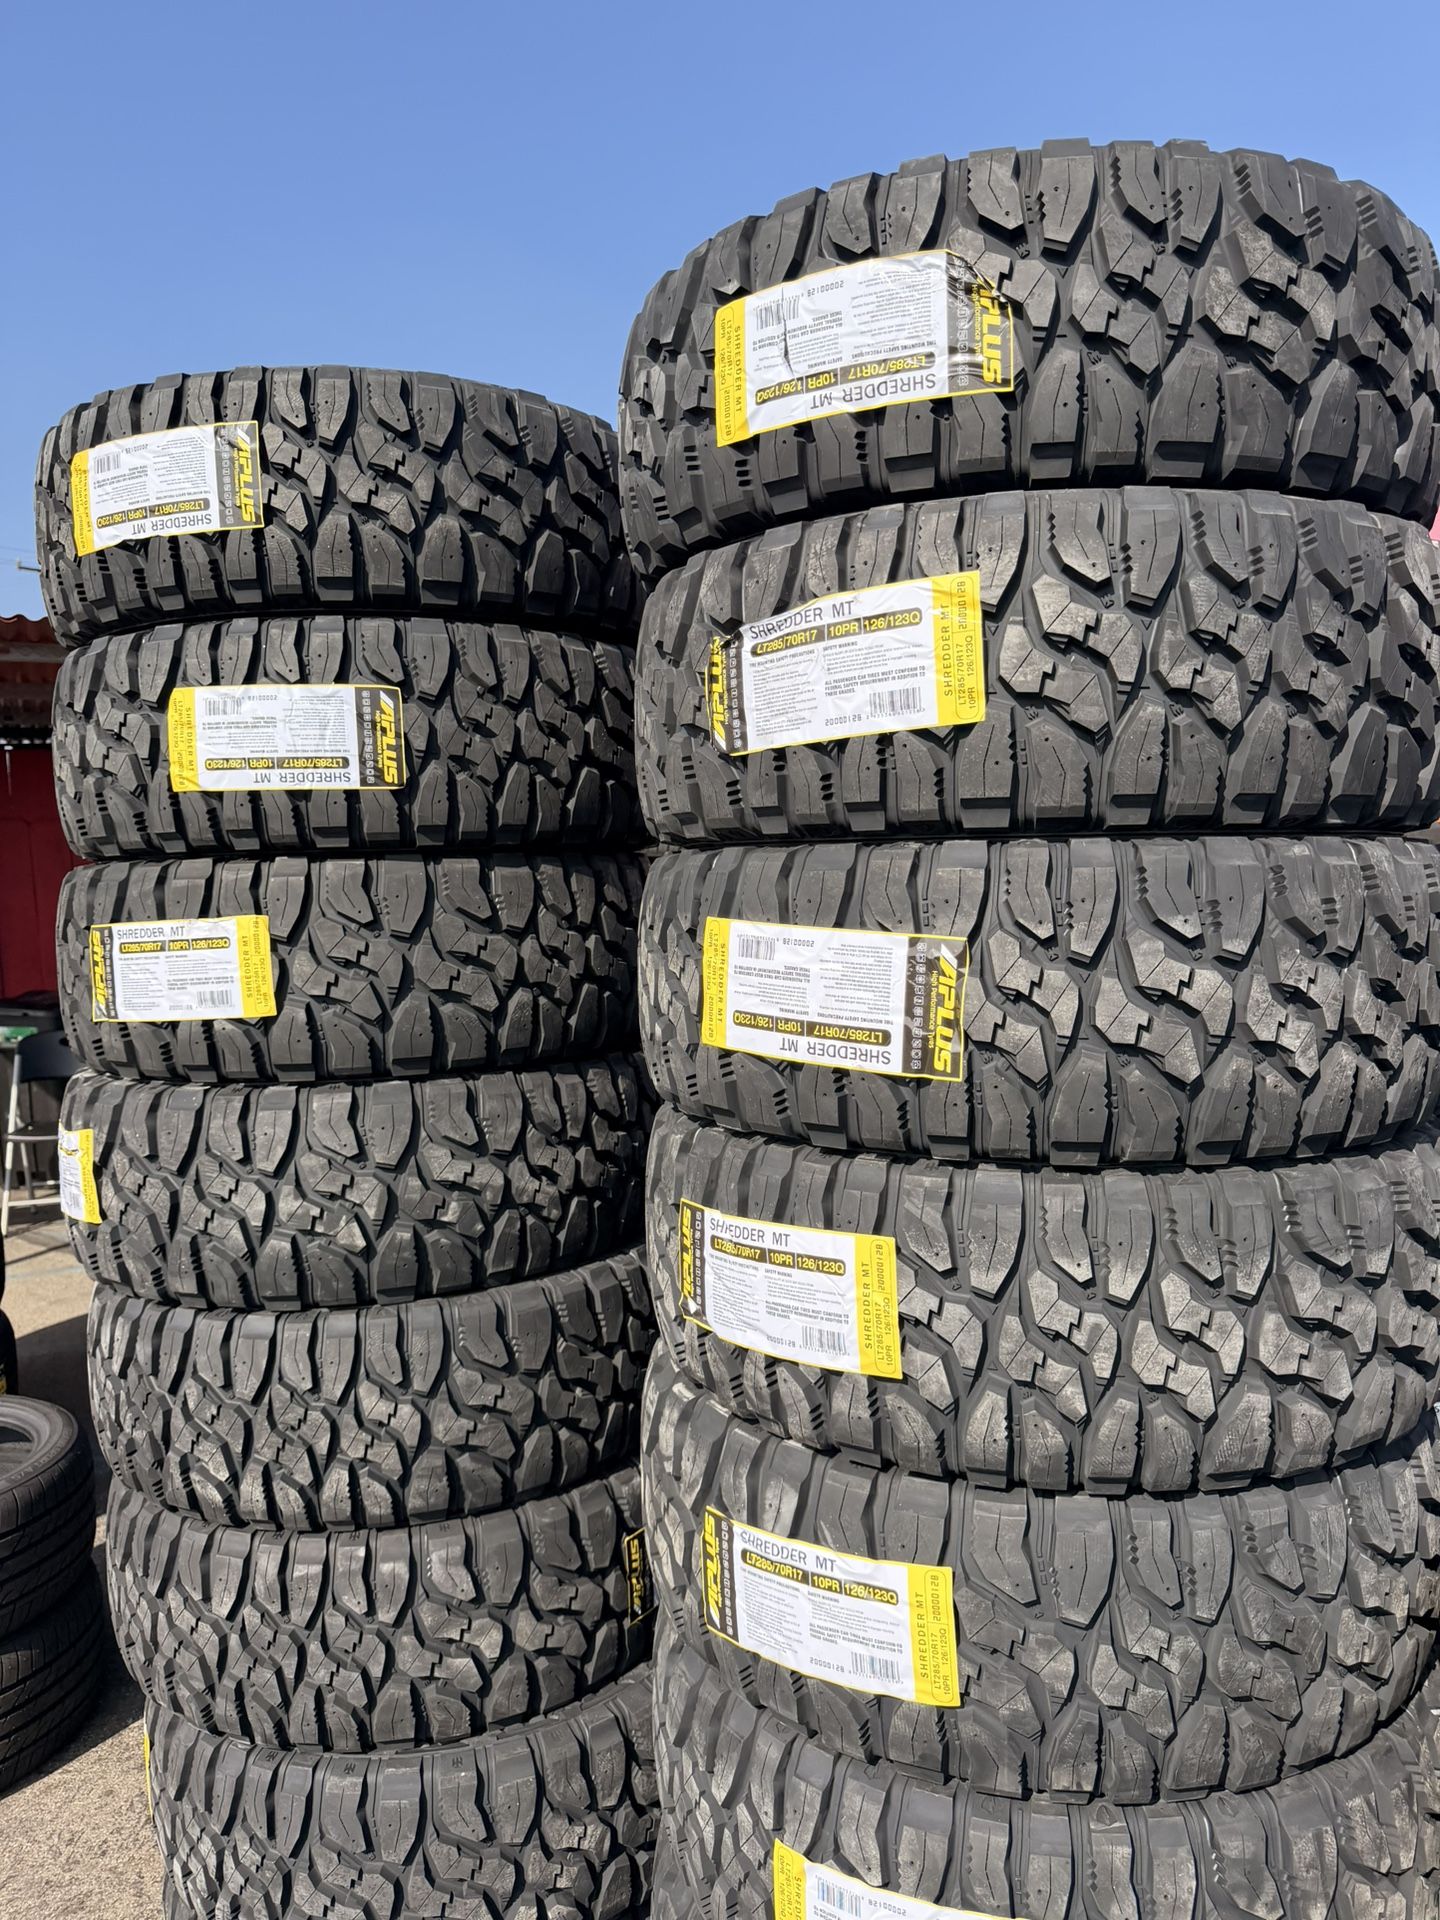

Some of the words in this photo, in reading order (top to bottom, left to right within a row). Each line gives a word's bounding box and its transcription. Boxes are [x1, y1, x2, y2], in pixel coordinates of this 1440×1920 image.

[979, 288, 1002, 384] PLUS
[734, 325, 743, 390] SHREDDER
[848, 354, 926, 380] LT285/70R17
[807, 375, 836, 389] 10PR
[842, 373, 936, 402] SHREDDER
[735, 394, 743, 413] MT
[810, 391, 833, 409] MT
[128, 508, 146, 520] 10PR
[154, 500, 205, 515] LT285/70R17
[131, 521, 146, 536] MT
[151, 513, 212, 532] SHREDDER
[832, 600, 855, 619] MT
[756, 629, 818, 656] LT285/70R17
[829, 623, 859, 638] 10PR
[864, 611, 921, 631] 126/123Q
[941, 625, 953, 697] SHREDDER
[965, 635, 975, 677] 126/123Q
[956, 643, 967, 706] LT285/70R17
[968, 686, 976, 710] 10PR
[825, 714, 862, 727] 20000128
[206, 758, 246, 769] 126/123Q
[249, 758, 274, 769] 10PR
[283, 757, 343, 768] LT285/70R17
[253, 772, 271, 783] MT
[279, 771, 351, 784] SHREDDER
[117, 927, 165, 940] SHREDDER
[170, 926, 185, 937] MT
[783, 937, 815, 948] 20000128
[168, 940, 189, 950] 10PR
[192, 937, 230, 949] 126/123Q
[717, 943, 726, 1004] SHREDDER
[717, 1007, 724, 1023] MT
[929, 987, 938, 1030] Performance
[734, 1012, 773, 1028] 126/123Q
[777, 1019, 802, 1032] 10PR
[814, 1024, 883, 1044] LT285/70R17
[780, 1037, 798, 1053] MT
[806, 1040, 891, 1065] SHREDDER
[772, 1231, 791, 1247] MT
[770, 1253, 793, 1266] 10PR
[797, 1257, 846, 1274] 126/123Q
[861, 1261, 870, 1278] MT
[875, 1243, 886, 1291] 20000128
[863, 1282, 873, 1349] SHREDDER
[883, 1296, 892, 1336] 126/123Q
[875, 1302, 885, 1361] LT285/70R17
[884, 1345, 893, 1366] 10PR
[739, 1530, 808, 1566] SHREDDER
[815, 1555, 837, 1573] MT
[746, 1552, 804, 1581] LT285/70R17
[812, 1575, 840, 1592] 10PR
[844, 1584, 897, 1605] 126/123Q
[915, 1592, 924, 1608] MT
[930, 1574, 941, 1622] 20000128
[917, 1613, 929, 1679] SHREDDER
[938, 1628, 949, 1666] 126/123Q
[809, 1656, 845, 1673] 20000128
[931, 1632, 942, 1690] LT285/70R17
[943, 1674, 951, 1695] 10PR
